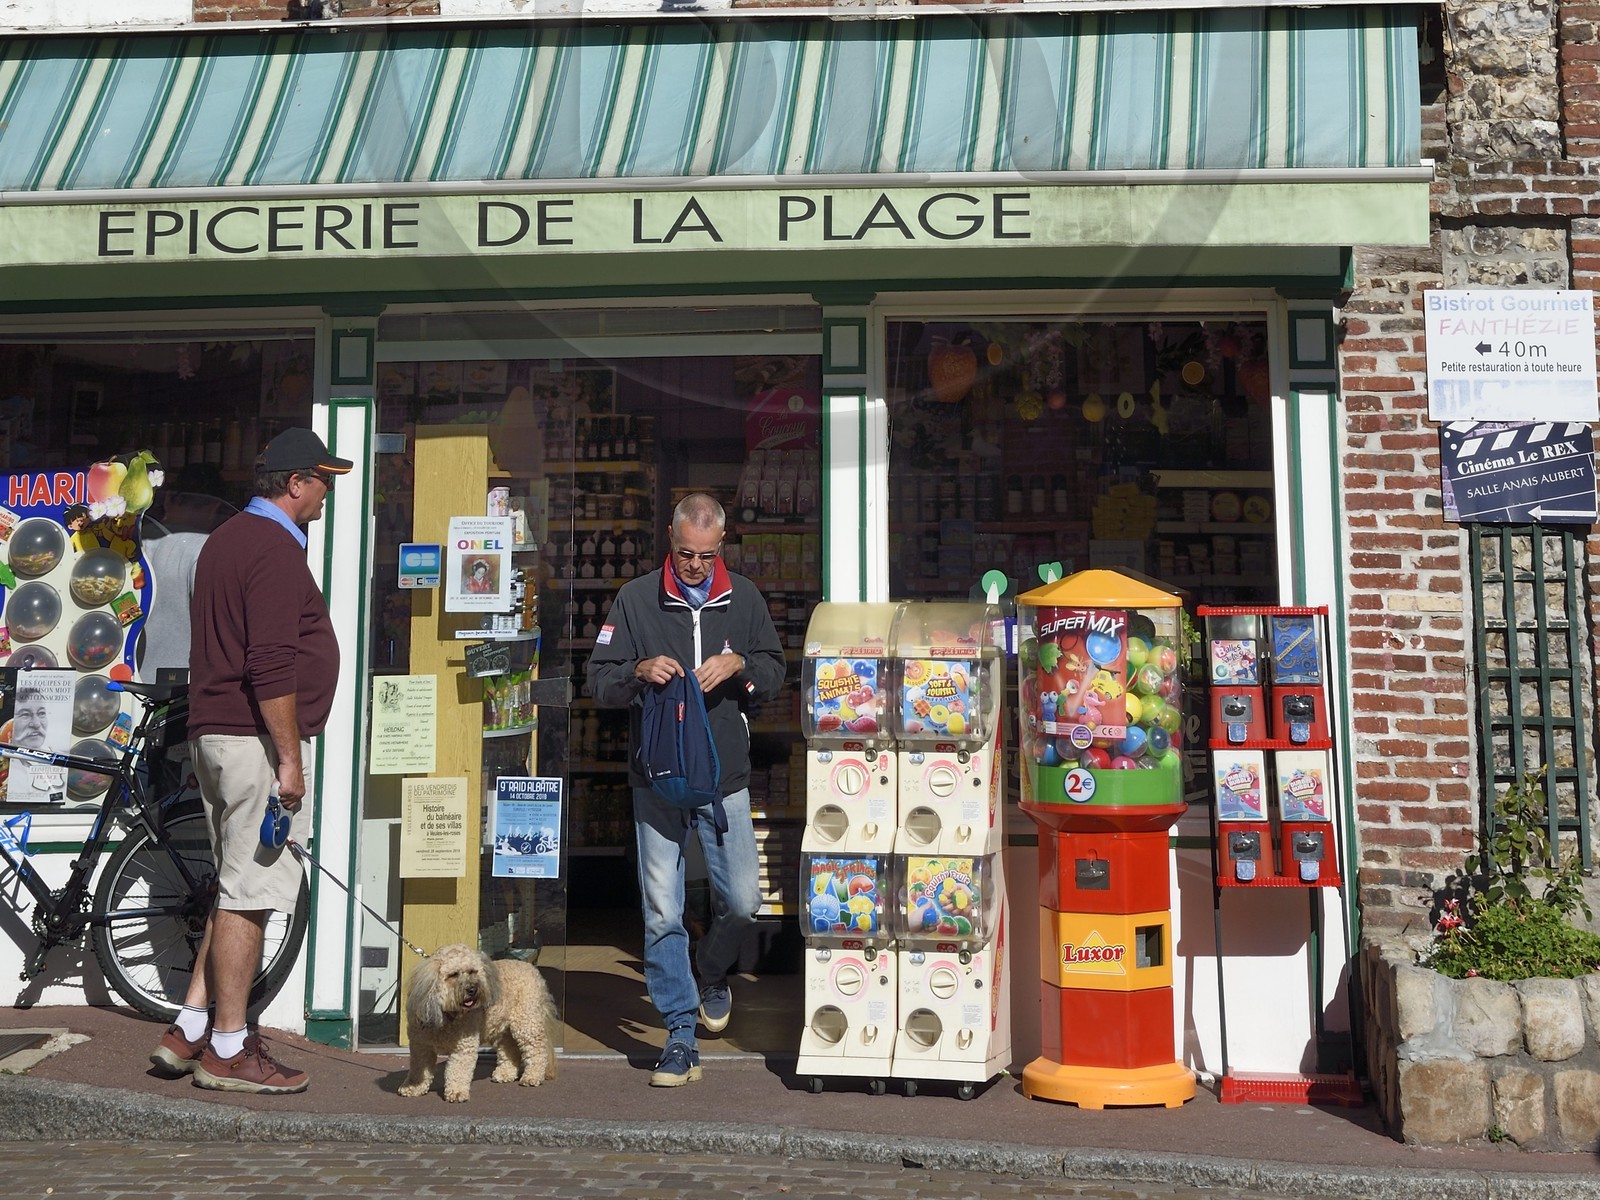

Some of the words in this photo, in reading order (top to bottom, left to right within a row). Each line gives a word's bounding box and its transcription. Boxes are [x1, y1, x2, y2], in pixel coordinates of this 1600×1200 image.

[98, 203, 419, 257] EPICERIE
[477, 201, 573, 247] DE
[633, 196, 723, 244] LA
[779, 192, 1031, 241] PLAGE
[1429, 296, 1495, 311] Bistrot
[1502, 295, 1588, 311] Gourmet
[1439, 313, 1580, 336] FANTHÉZIE
[1441, 361, 1466, 372] Petite
[1468, 362, 1521, 372] restauration
[1524, 362, 1529, 372] à
[1531, 362, 1554, 372] toute
[1556, 362, 1582, 372] heure
[1457, 457, 1515, 475] Cinéma
[1517, 450, 1538, 464] Le
[1541, 440, 1579, 460] REX
[9, 472, 95, 507] HARI
[1466, 483, 1500, 499] SALLE
[1541, 467, 1585, 484] AUBERT
[457, 539, 504, 550] ONEL
[1041, 616, 1086, 637] SUPER
[1087, 613, 1125, 638] MIX
[466, 643, 491, 656] OUVERT
[818, 674, 859, 690] SQUISHIE
[928, 679, 947, 688] SOFT
[818, 683, 861, 701] ANIMALS
[926, 687, 956, 697] SQUISHY
[425, 783, 457, 791] VENDREDIS
[508, 781, 526, 792] RAID
[527, 779, 558, 793] ALBÂTRE
[422, 804, 445, 813] Histoire
[426, 813, 434, 821] du
[435, 813, 462, 821] balnéaire
[446, 821, 462, 829] villas
[811, 861, 840, 877] MAGIC
[925, 870, 949, 898] Squishy
[1064, 944, 1125, 963] Luxor
